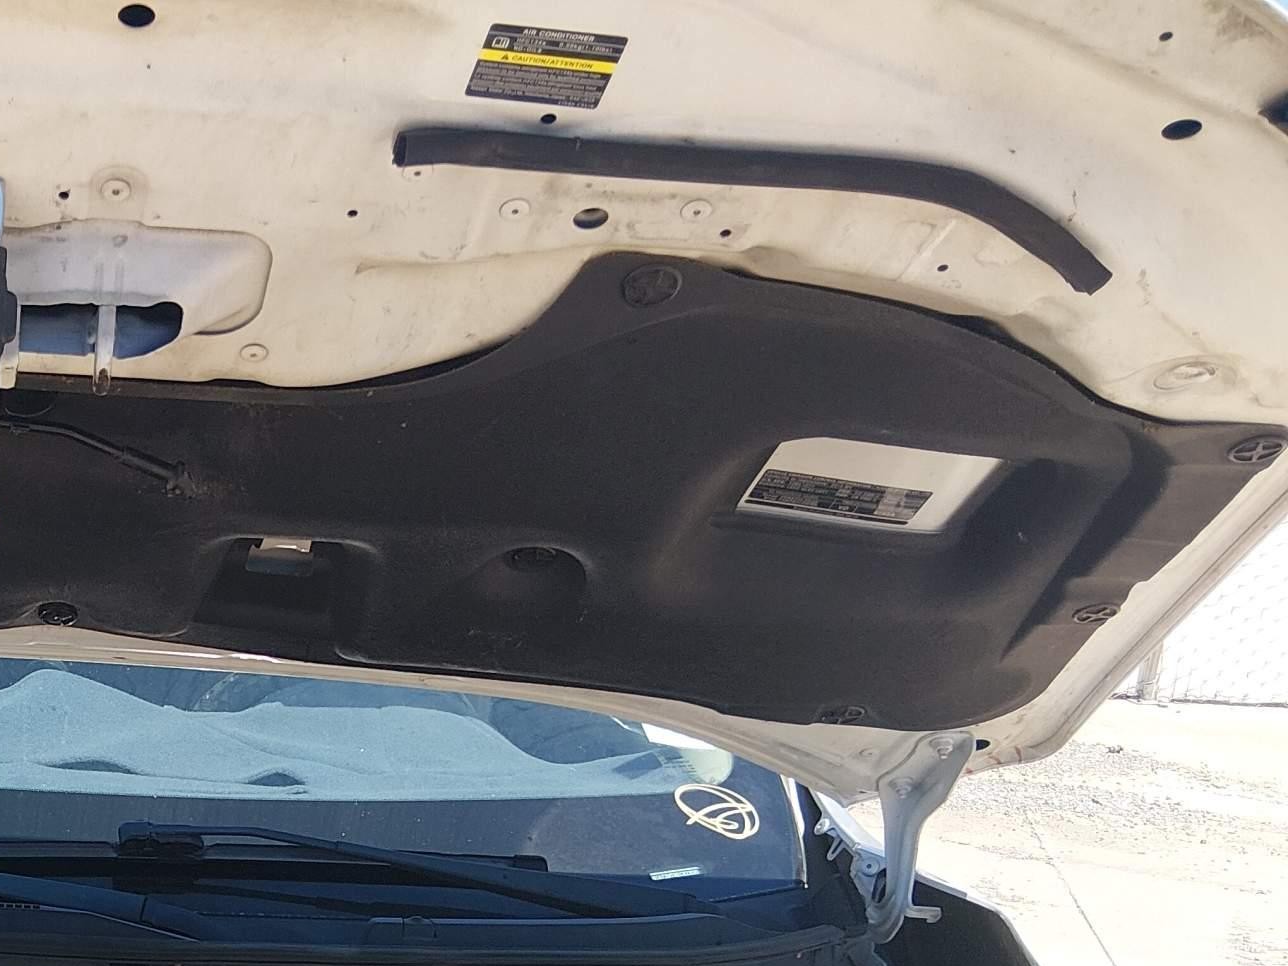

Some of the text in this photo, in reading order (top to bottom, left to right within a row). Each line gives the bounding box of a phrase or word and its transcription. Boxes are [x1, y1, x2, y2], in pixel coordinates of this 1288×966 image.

[523, 28, 595, 41] AIR CONDITIONER
[511, 54, 594, 69] CAUTION/ATTENTION
